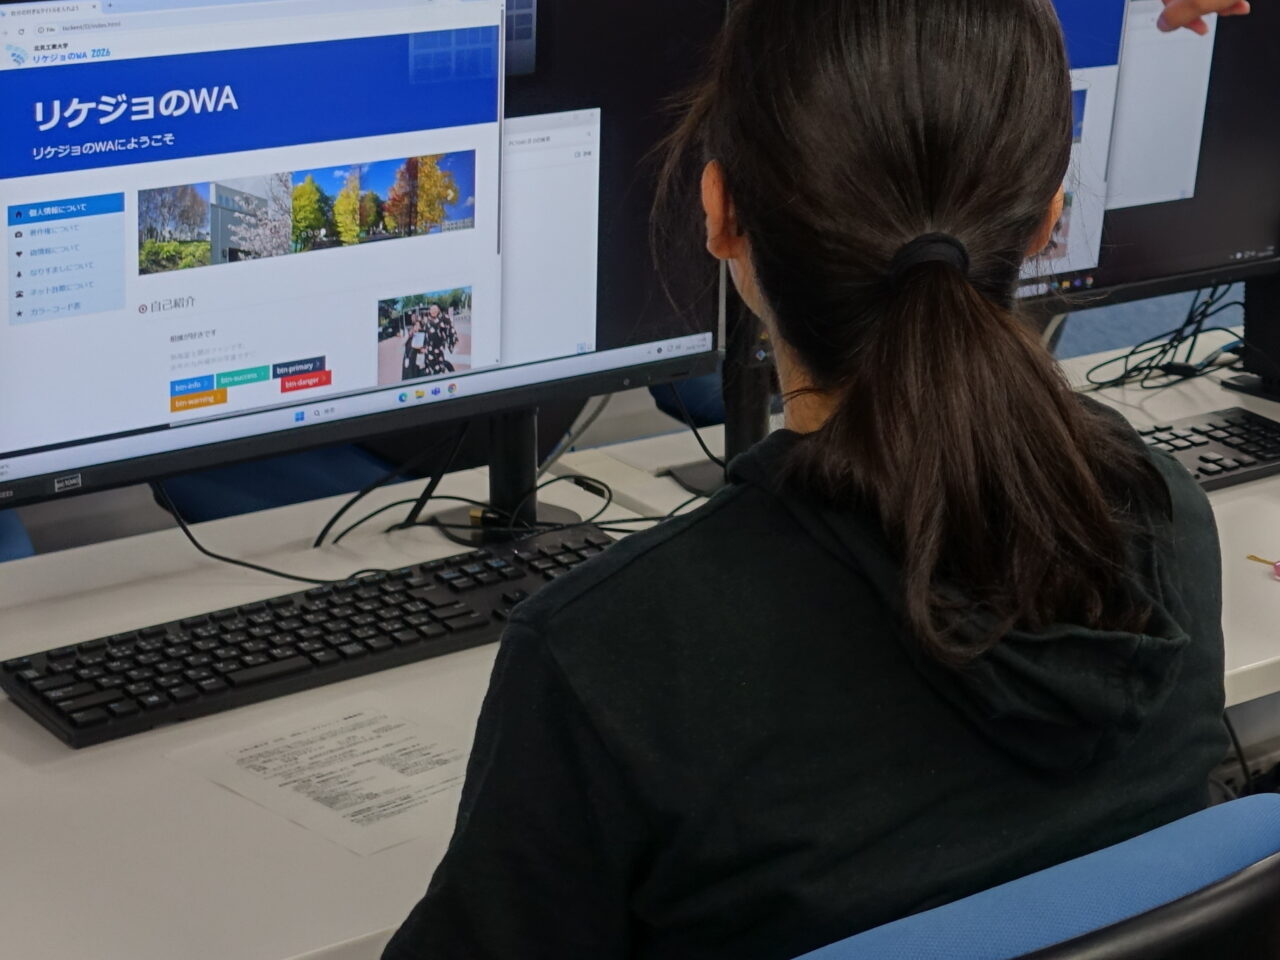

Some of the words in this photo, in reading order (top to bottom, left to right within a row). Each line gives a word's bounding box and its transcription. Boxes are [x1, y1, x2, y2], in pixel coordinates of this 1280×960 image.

[33, 50, 87, 64] リケジョのWA
[91, 47, 111, 58] 2026
[35, 85, 239, 131] リケジョのWA
[33, 133, 175, 160] リケジョのWAにようこそ
[29, 203, 87, 217] 個人情報について
[150, 296, 195, 313] 自己紹介
[276, 360, 313, 374] btn-primary
[175, 381, 202, 392] btn-info
[285, 376, 319, 389] btn-danger
[175, 394, 214, 408] btn-warning
